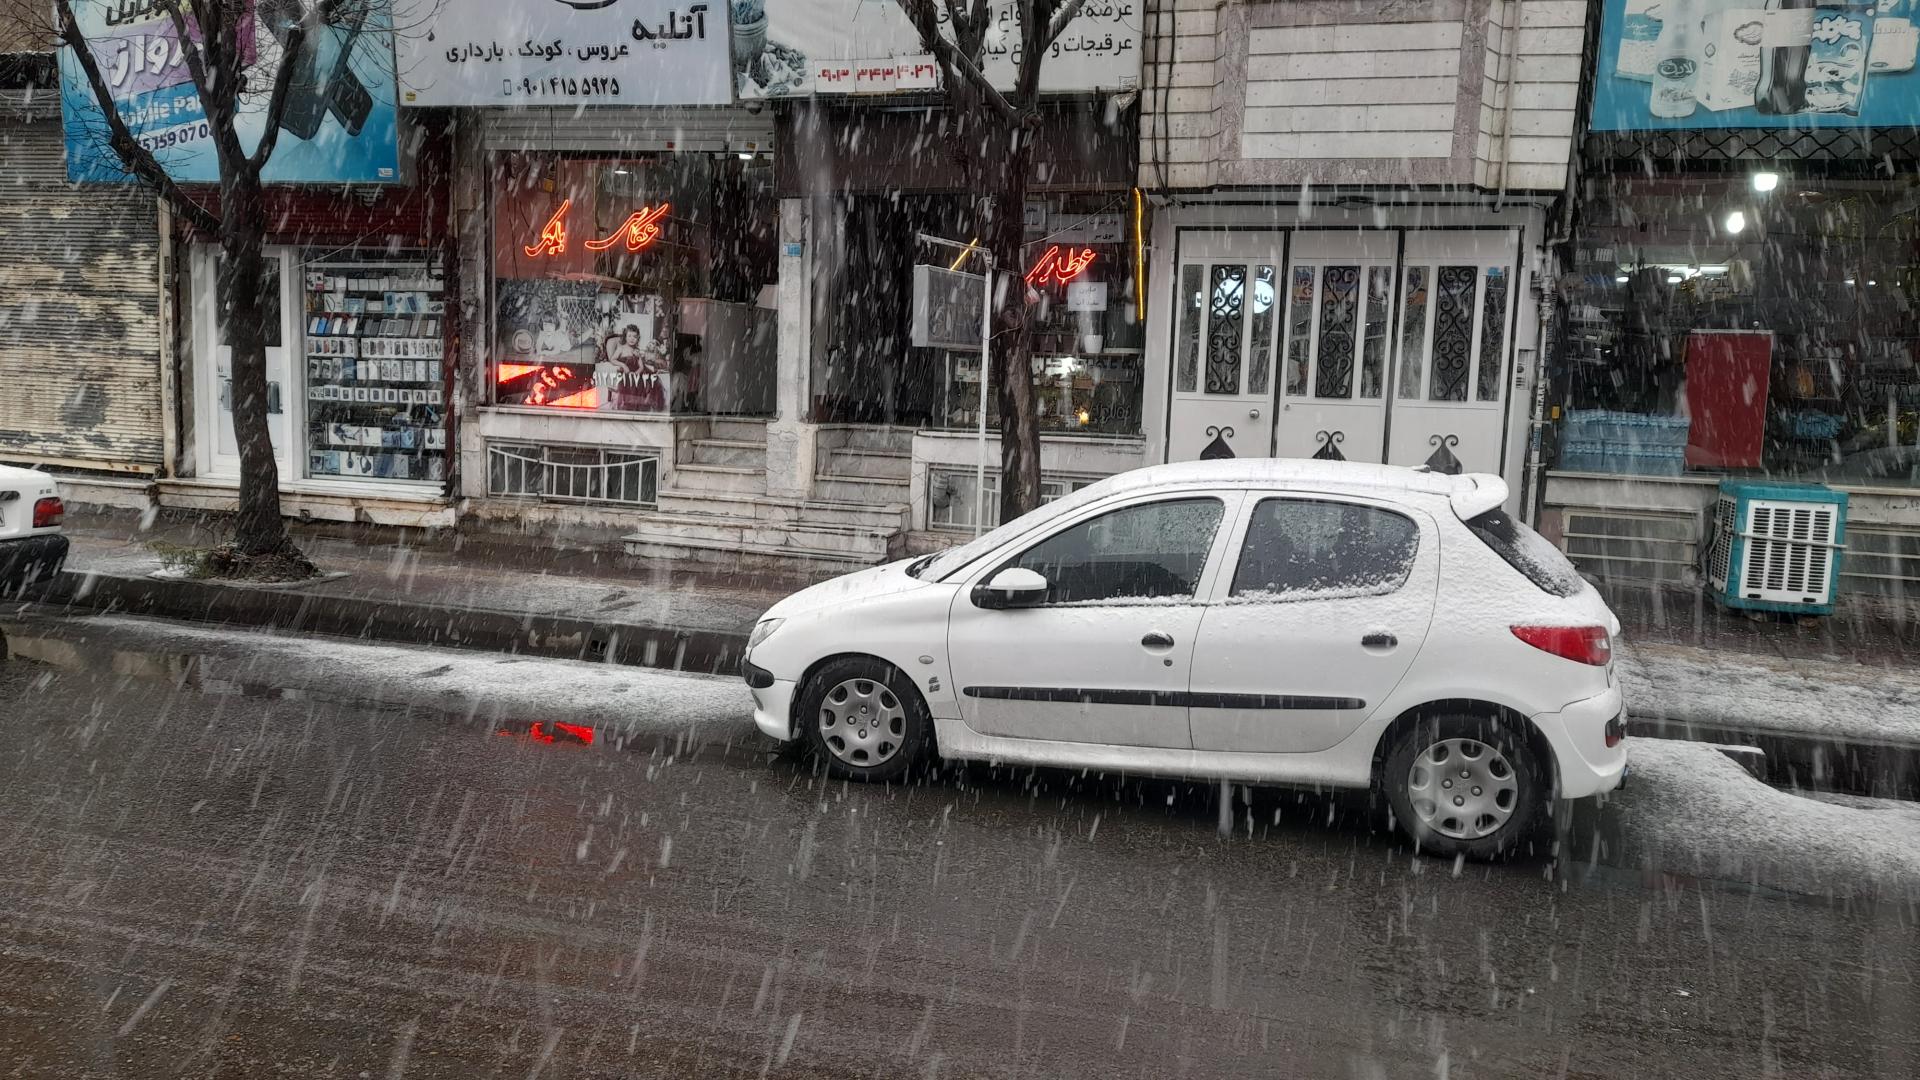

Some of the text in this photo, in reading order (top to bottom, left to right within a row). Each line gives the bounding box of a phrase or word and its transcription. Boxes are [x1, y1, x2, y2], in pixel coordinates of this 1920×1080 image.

[632, 4, 707, 49] آتلیه
[446, 41, 504, 63] بارداری
[518, 40, 563, 61] کودک
[577, 44, 629, 61] عروس
[1052, 33, 1133, 58] عرقیجات و
[1025, 245, 1096, 284] عطاری
